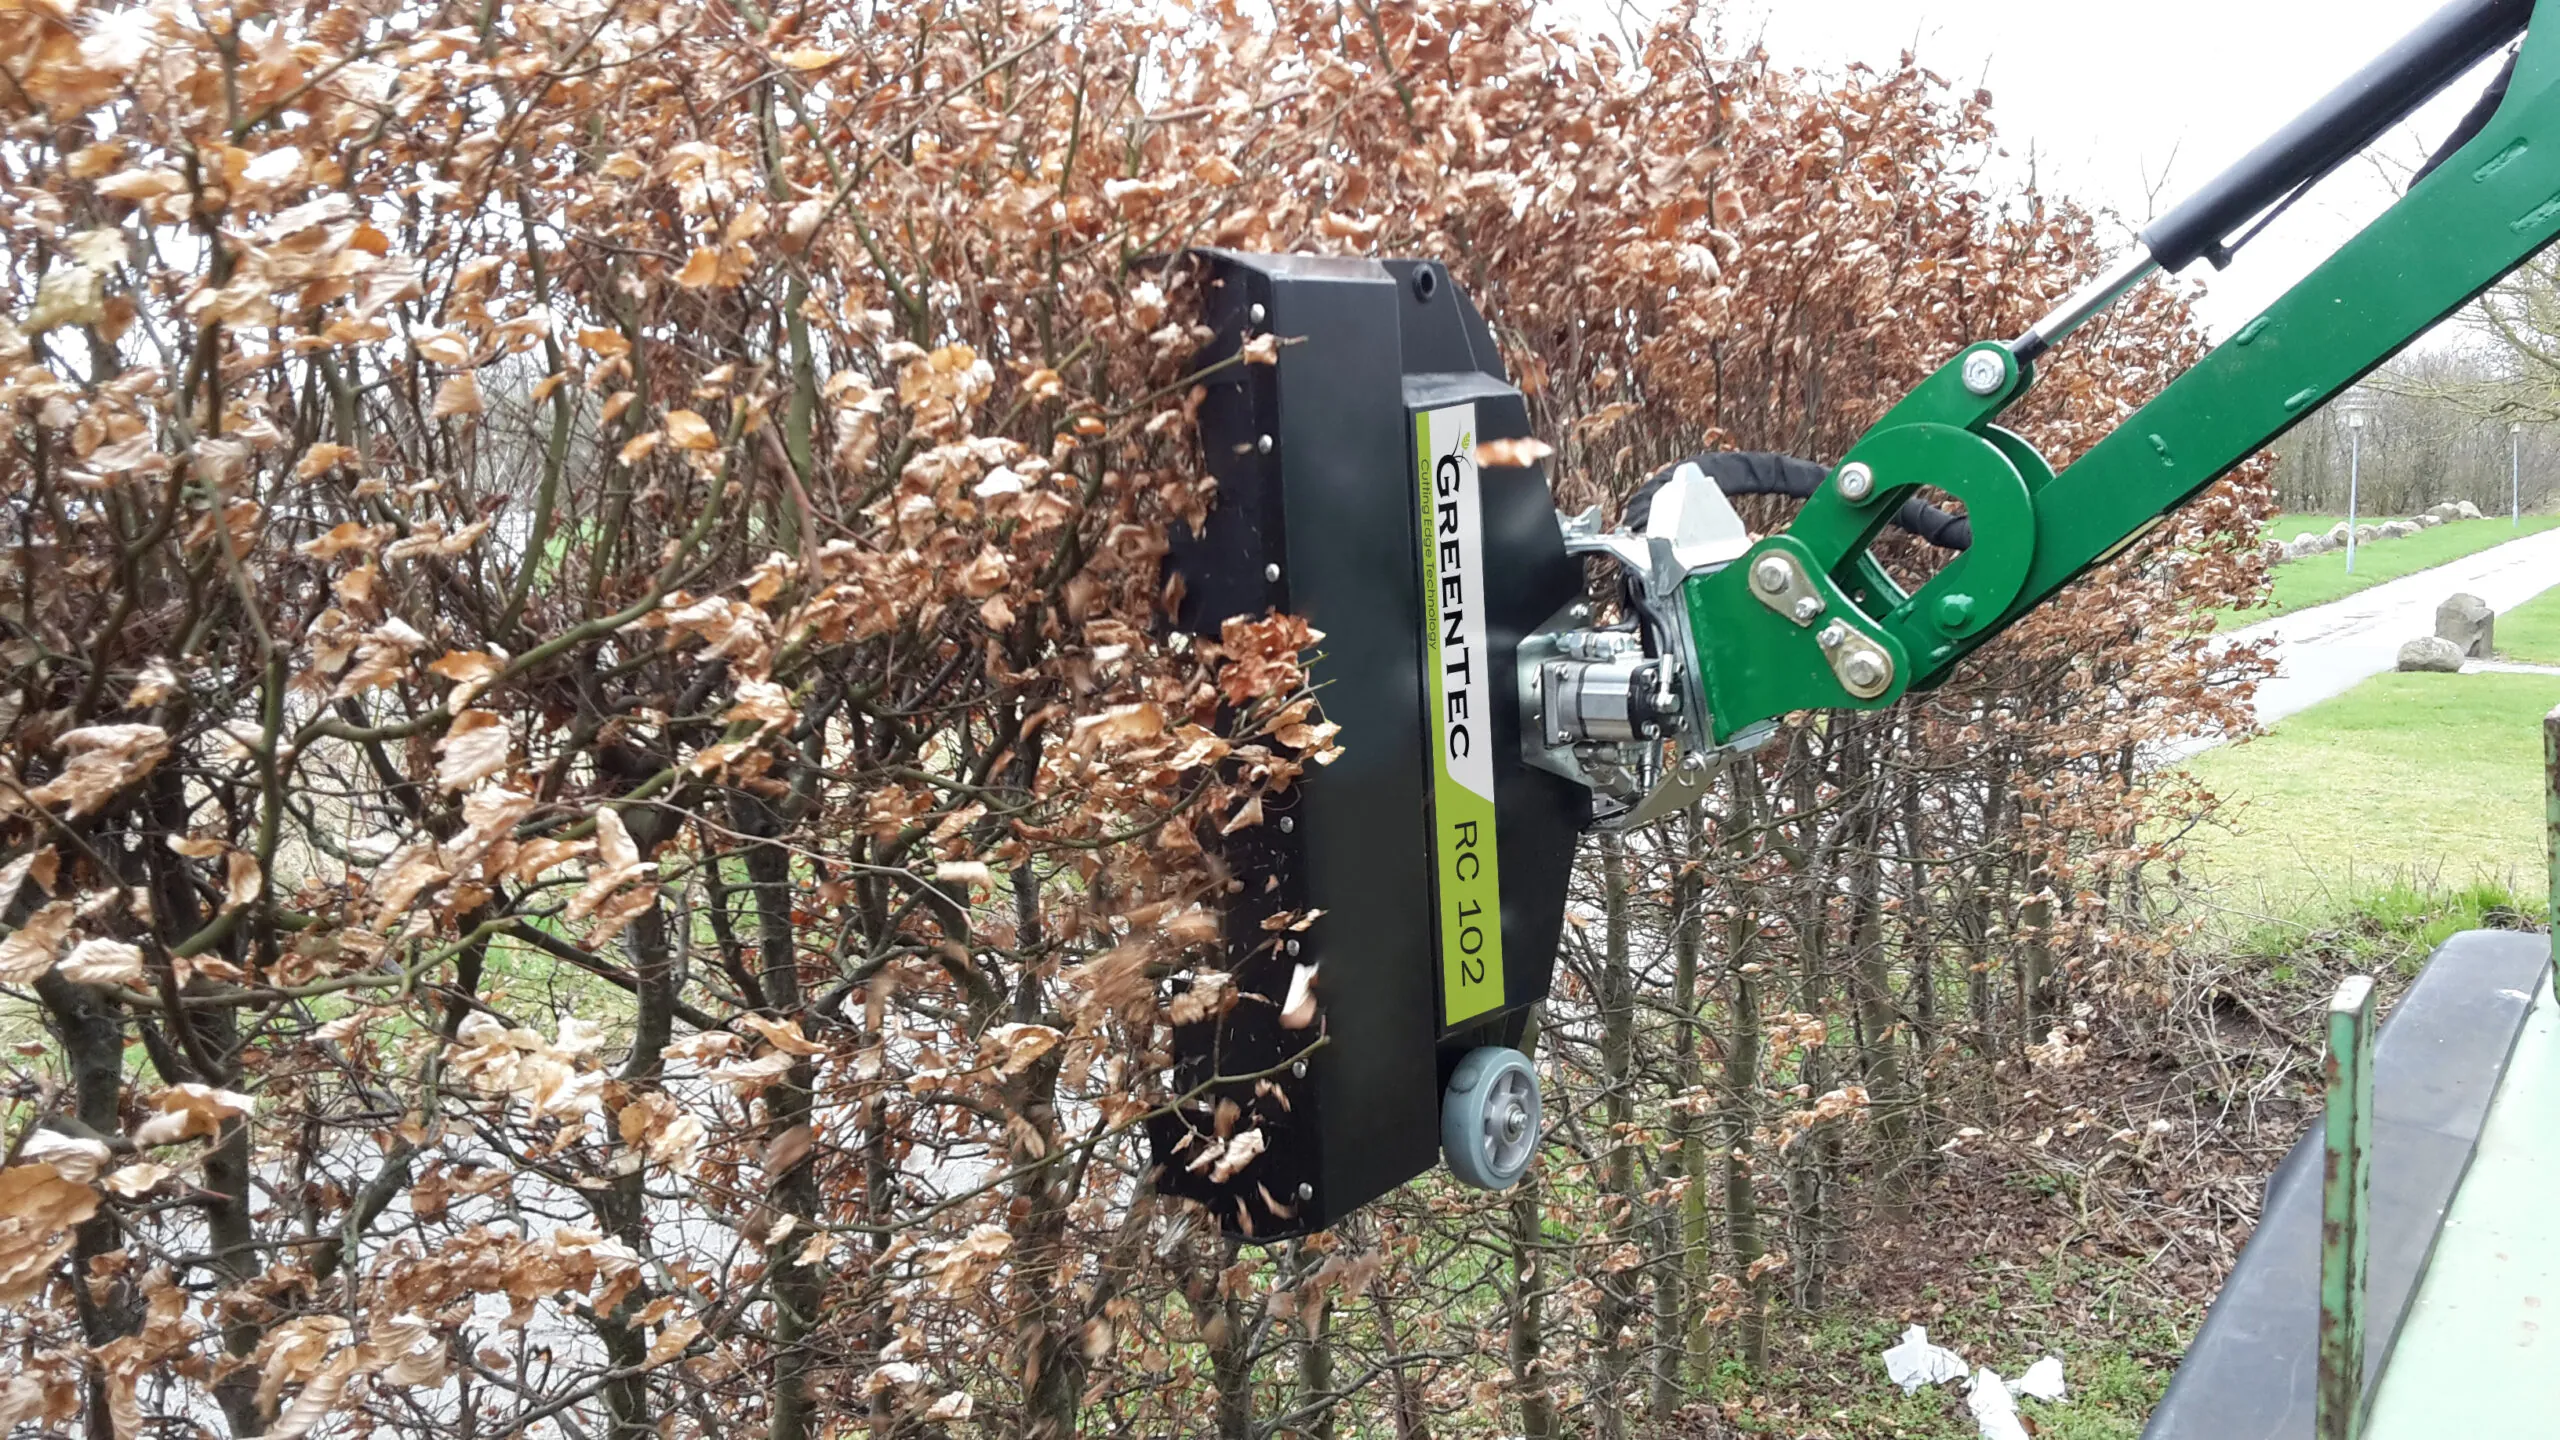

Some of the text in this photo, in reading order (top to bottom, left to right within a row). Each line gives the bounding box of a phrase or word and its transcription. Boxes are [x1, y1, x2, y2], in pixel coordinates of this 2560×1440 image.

[1420, 457, 1437, 651] Cutting Edge Technology
[1436, 453, 1471, 760] GREENTEC
[1454, 820, 1486, 987] RC 102
